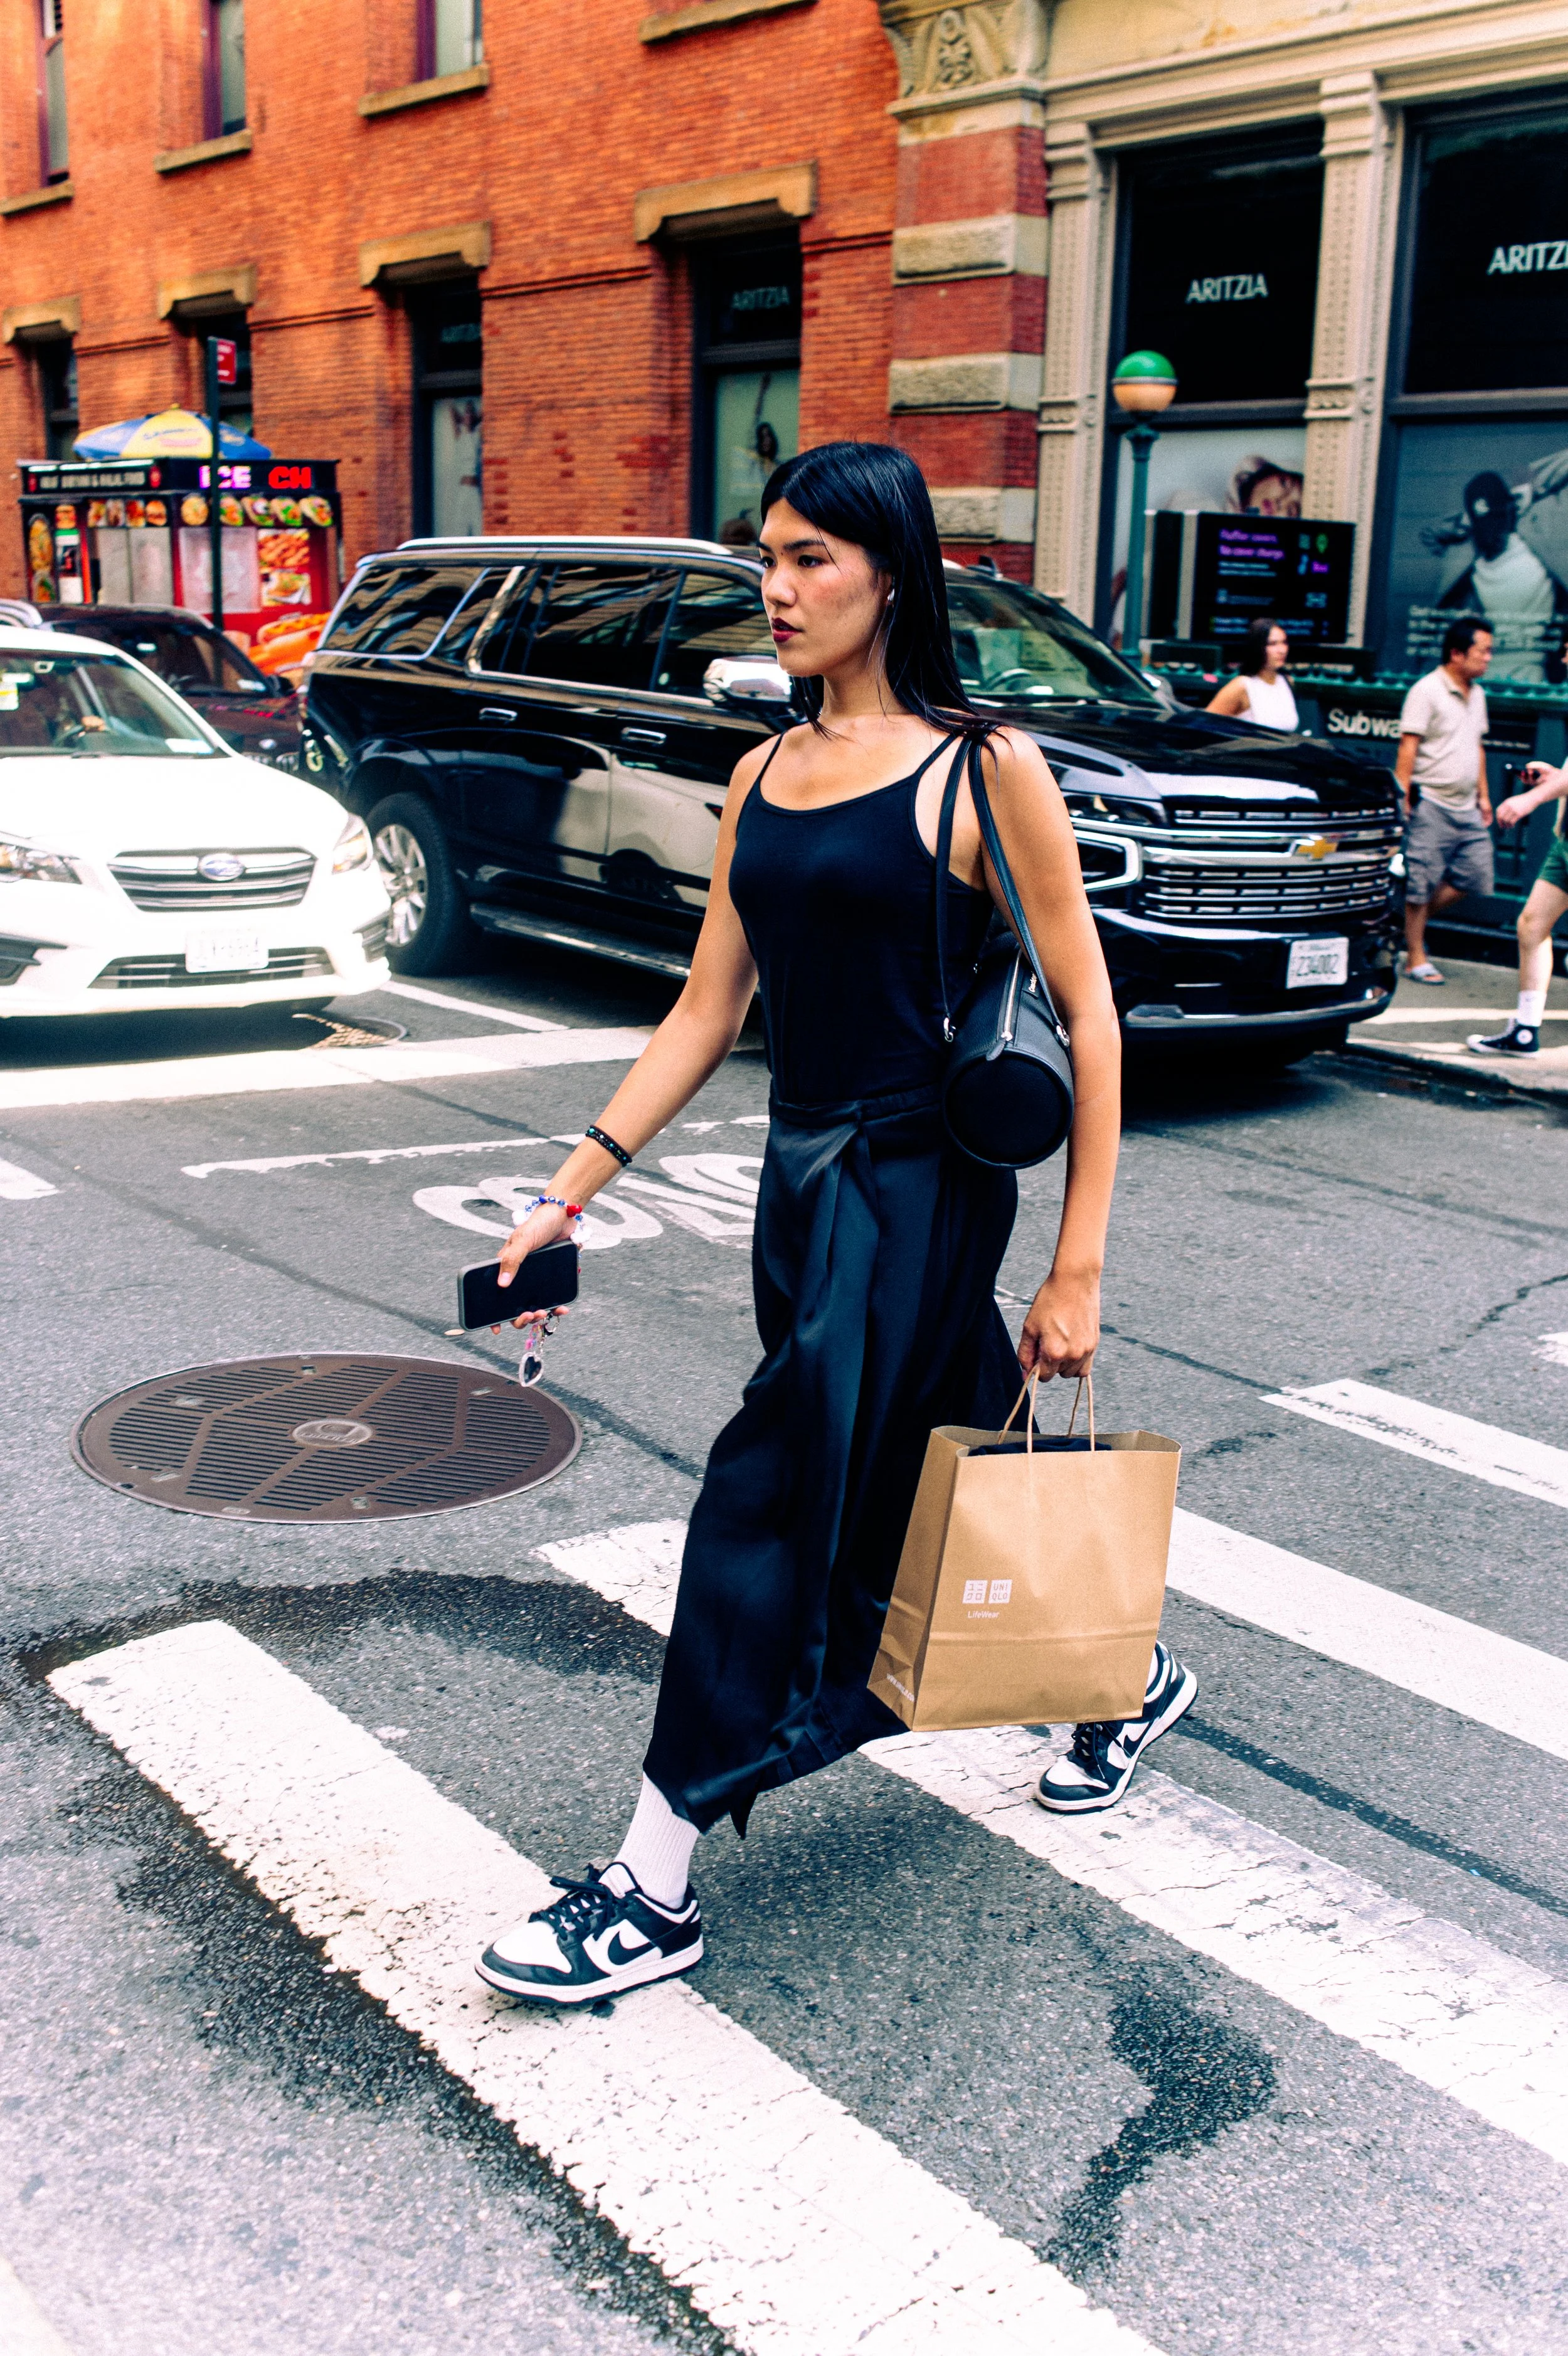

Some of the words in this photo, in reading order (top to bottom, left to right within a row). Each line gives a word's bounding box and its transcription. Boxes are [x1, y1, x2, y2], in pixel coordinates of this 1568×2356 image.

[1185, 273, 1268, 302] ARITZIA
[268, 466, 312, 489] CH
[1328, 708, 1401, 738] Subwa
[992, 1593, 1008, 1601] QLO
[993, 1583, 1009, 1591] UNI
